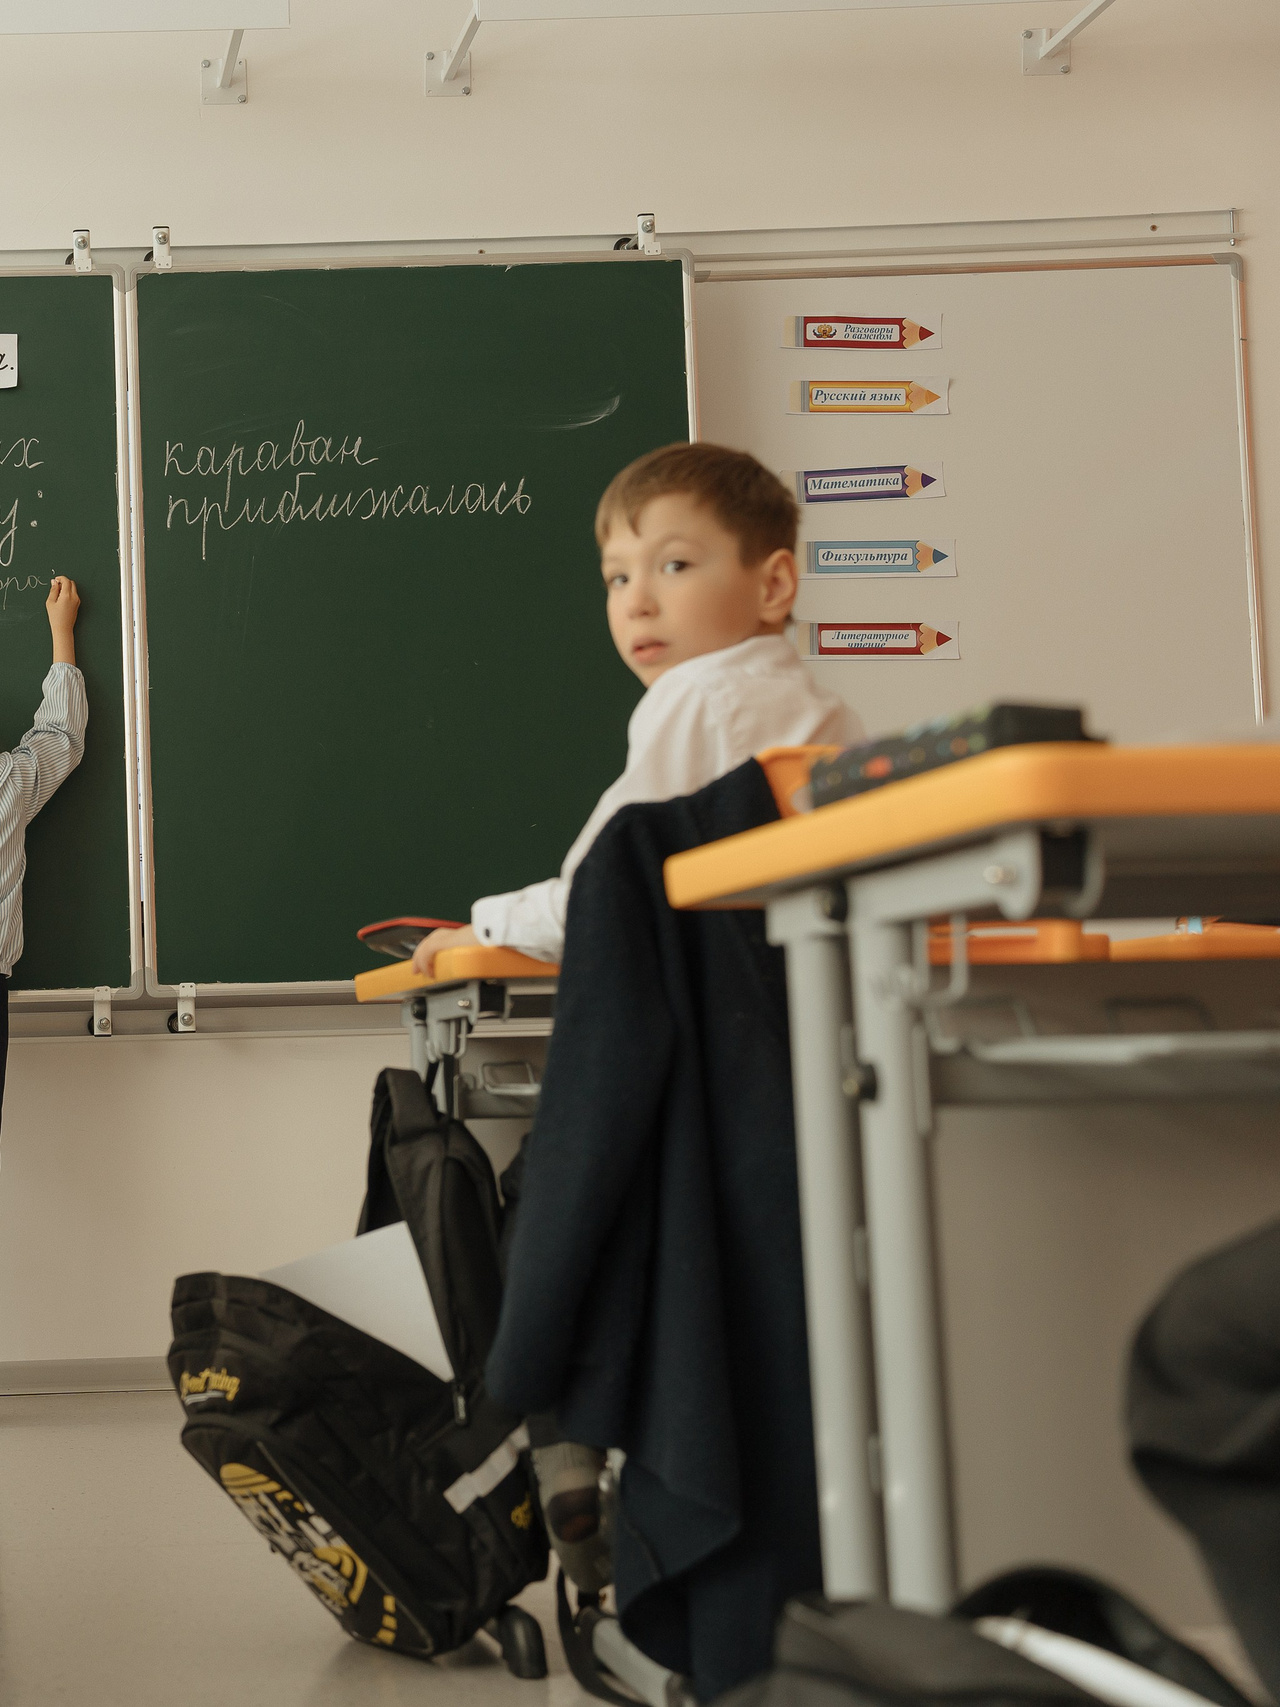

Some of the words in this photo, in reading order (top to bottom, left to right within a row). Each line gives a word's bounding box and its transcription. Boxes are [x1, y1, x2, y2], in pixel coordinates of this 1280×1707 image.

[843, 324, 894, 335] Разговоры
[813, 389, 866, 403] Русский
[869, 393, 902, 401] язык
[163, 418, 380, 512] караван
[809, 477, 900, 491] Математика
[166, 471, 532, 561] приближалась
[821, 550, 908, 564] Физкультура
[831, 631, 910, 642] Литературное
[847, 641, 887, 649] чтение
